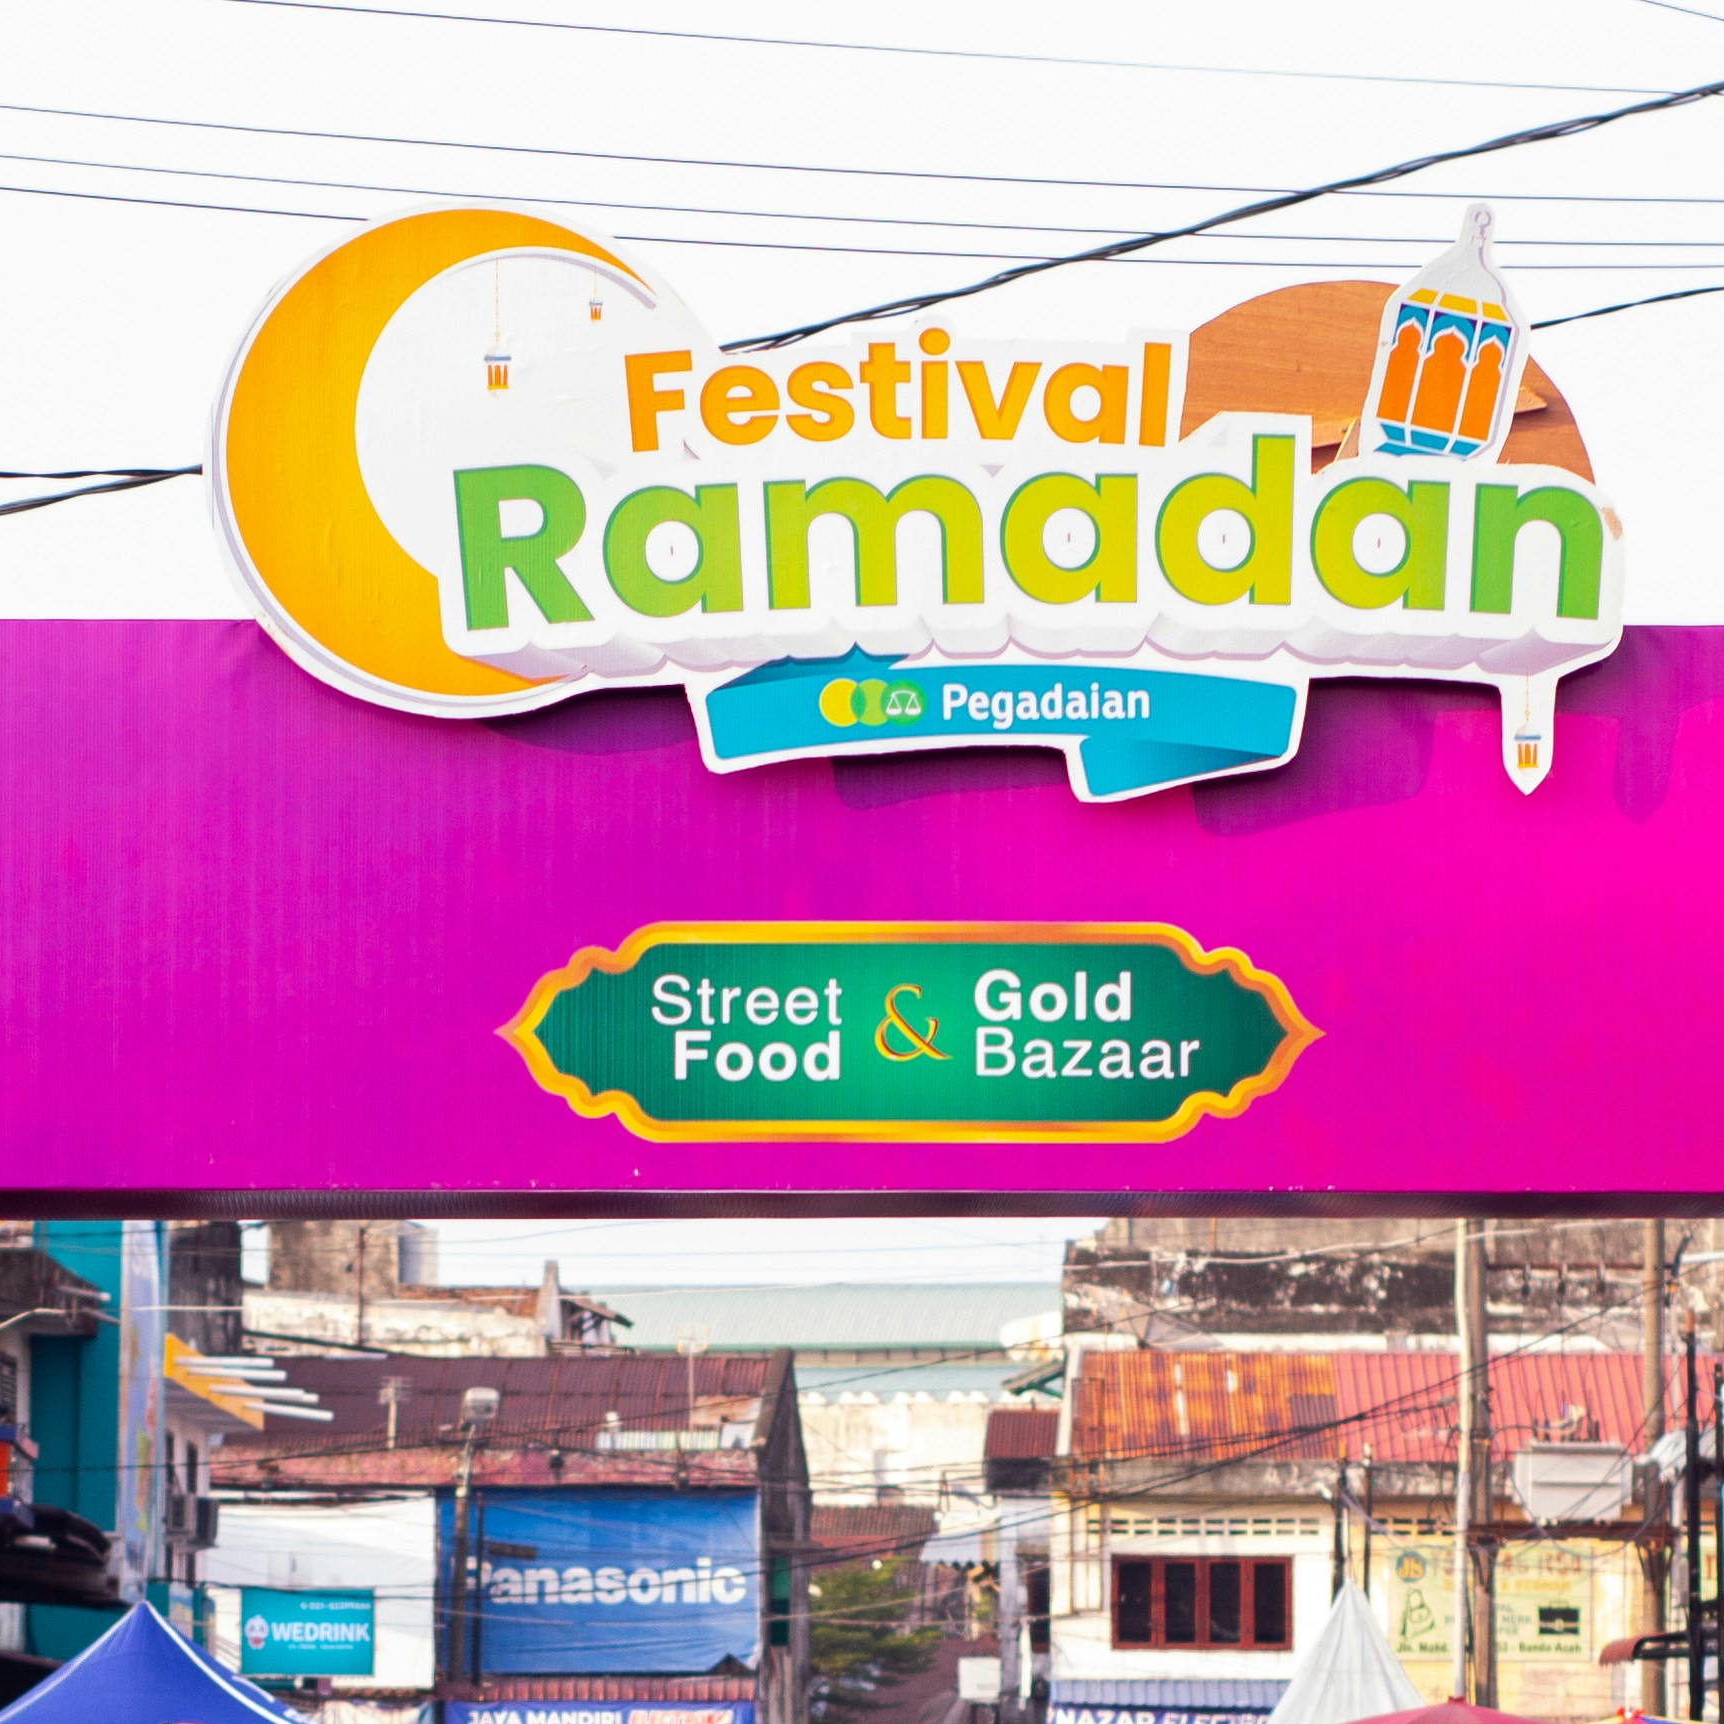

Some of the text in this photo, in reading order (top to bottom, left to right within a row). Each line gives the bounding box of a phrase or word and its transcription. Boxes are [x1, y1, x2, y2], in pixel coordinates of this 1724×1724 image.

[624, 326, 1176, 452] Festival
[453, 433, 1606, 631] Ramadan
[942, 682, 1151, 730] Pegadaian
[651, 973, 843, 1027] Street
[874, 983, 954, 1062] &
[973, 969, 1132, 1023] Gold
[674, 1029, 842, 1082] Food
[975, 1027, 1201, 1079] Bazaar
[271, 1621, 371, 1643] WEDRINK
